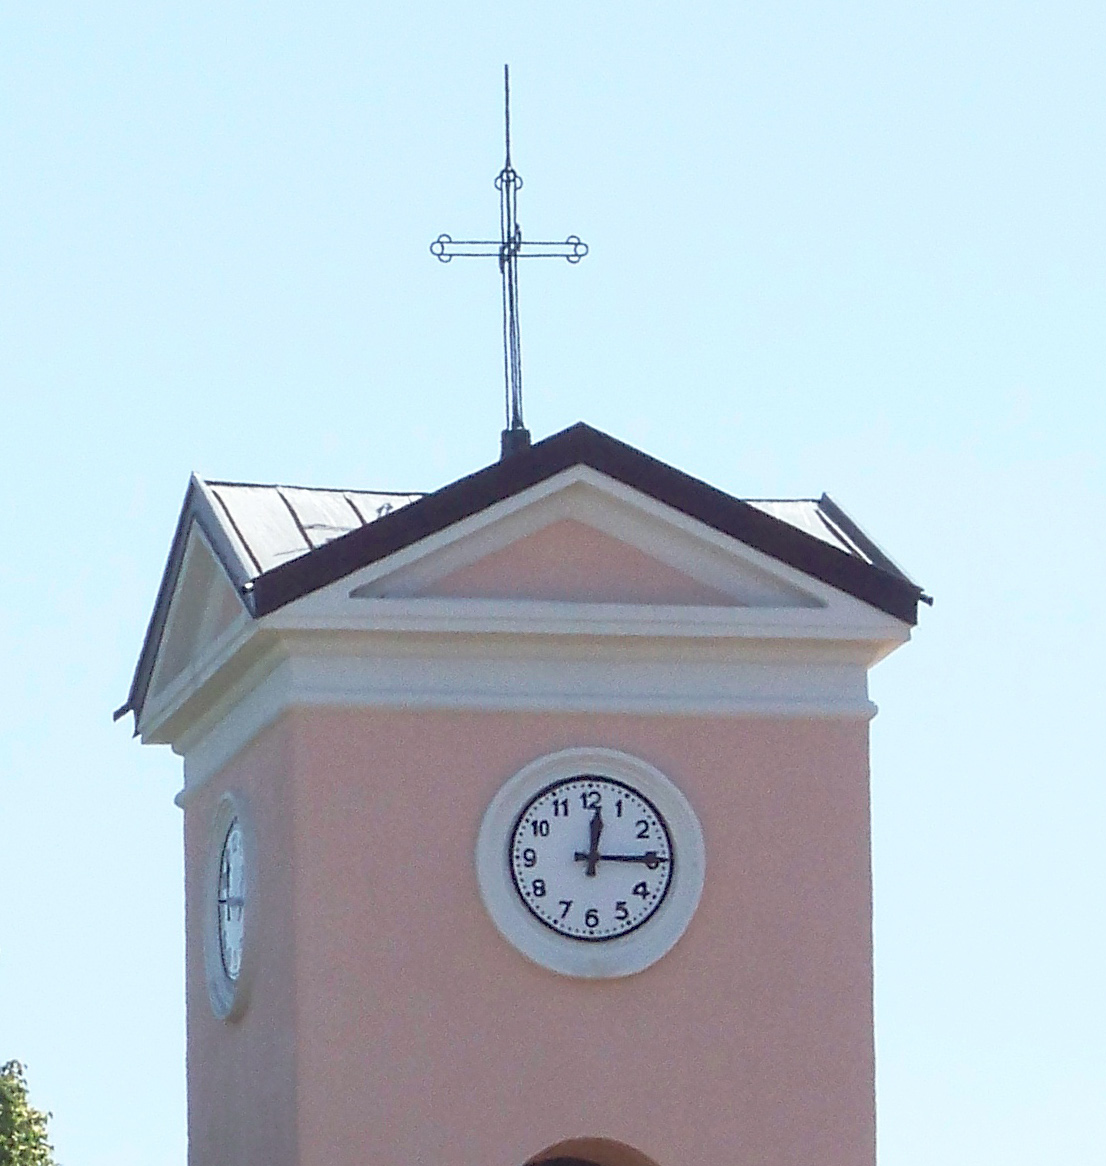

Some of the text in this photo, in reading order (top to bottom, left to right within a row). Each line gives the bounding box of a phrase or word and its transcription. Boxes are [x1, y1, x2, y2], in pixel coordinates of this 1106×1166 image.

[552, 799, 569, 817] 11
[580, 791, 602, 810] 12
[615, 799, 623, 818] 1
[531, 820, 550, 837] 10
[636, 820, 650, 839] 2
[523, 848, 537, 868] 9
[532, 879, 546, 897] 8
[632, 881, 651, 900] 4
[559, 900, 574, 919] 7
[585, 909, 599, 928] 6
[615, 901, 629, 920] 5
